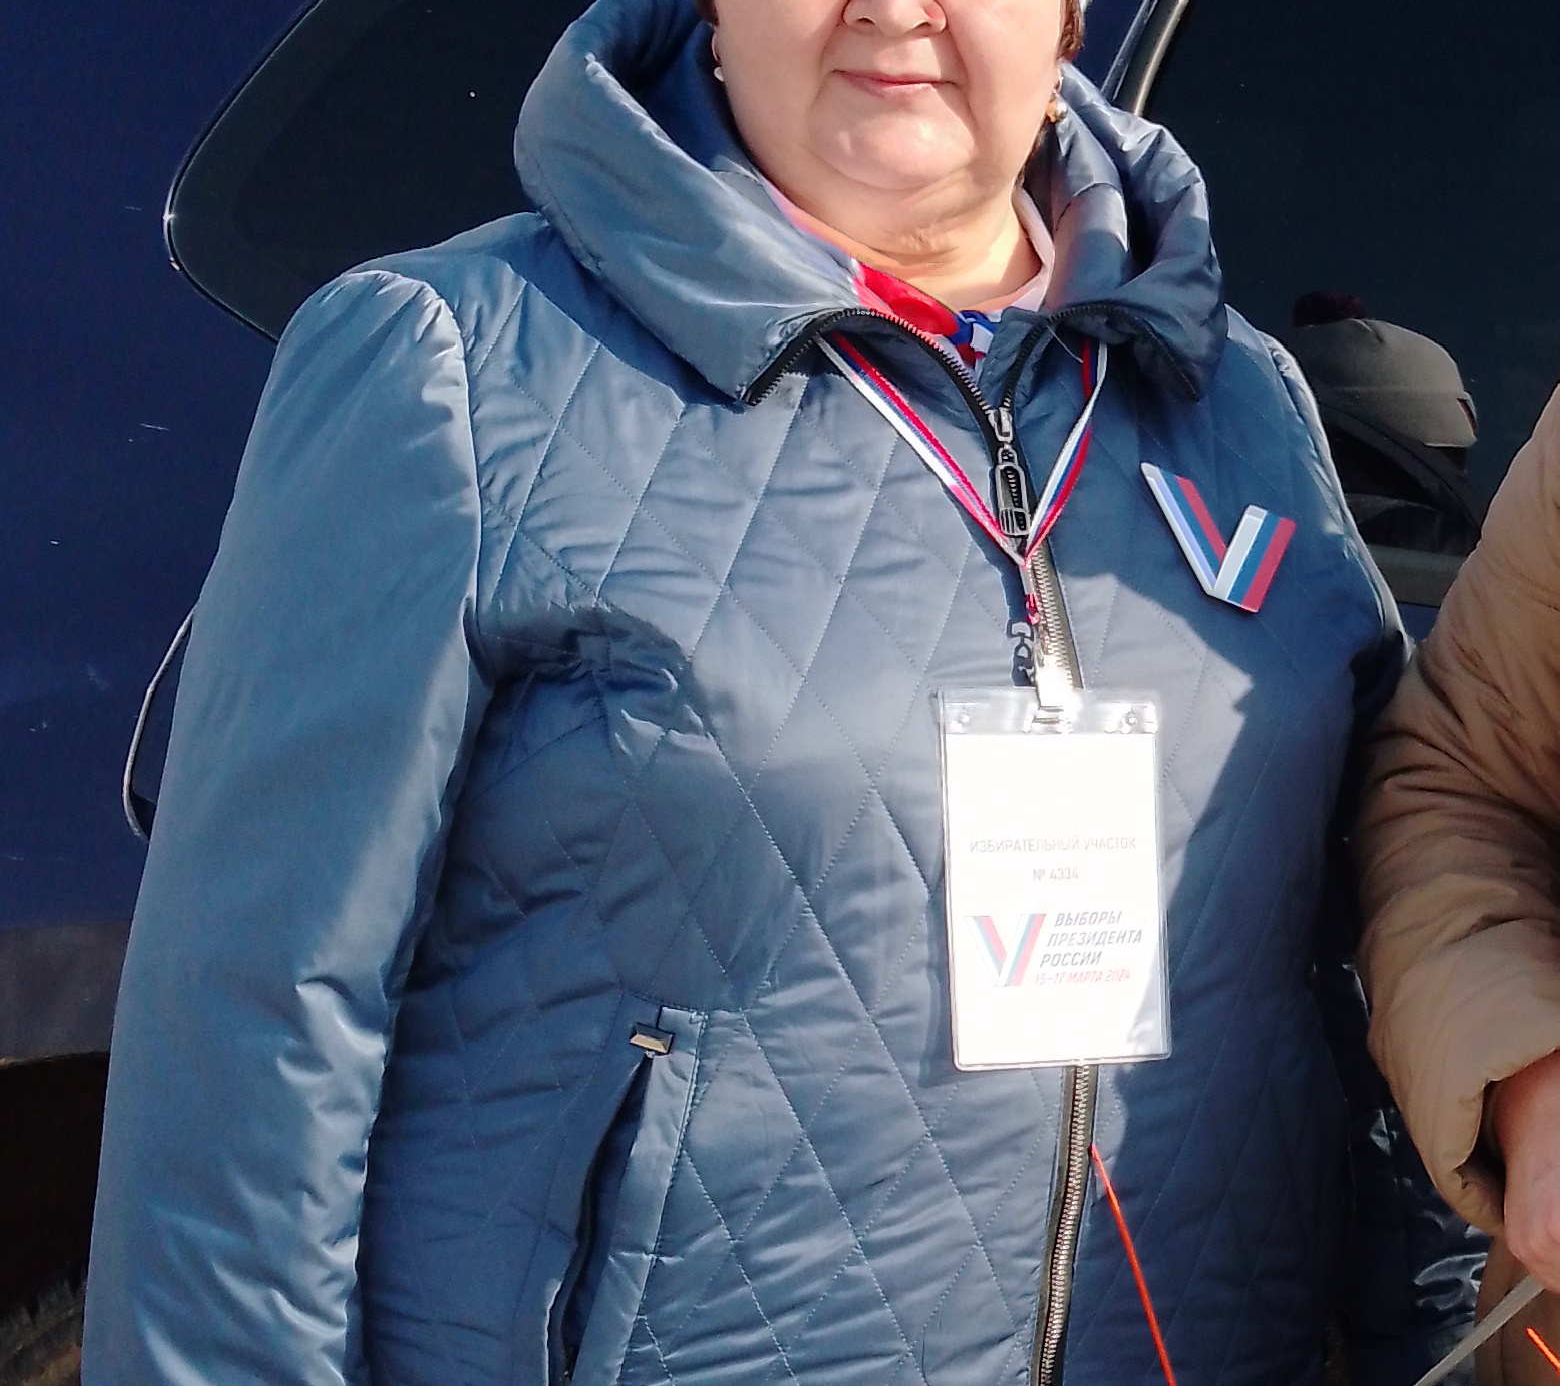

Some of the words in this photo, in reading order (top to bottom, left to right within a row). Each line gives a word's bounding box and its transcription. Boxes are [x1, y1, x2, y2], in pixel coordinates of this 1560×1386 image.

[969, 834, 1079, 853] ИЗБИРАТЕЛЬНЫЙ
[1083, 836, 1137, 851] УЧАСТОК
[1032, 867, 1046, 881] №
[1049, 866, 1079, 880] 4334
[1054, 910, 1122, 927] ВЫБОРЫ
[1047, 929, 1142, 948] ПРЕЗИДЕНТА
[1039, 952, 1103, 968] РОССИИ
[1067, 971, 1103, 985] МАРТА
[1106, 969, 1131, 983] 2024
